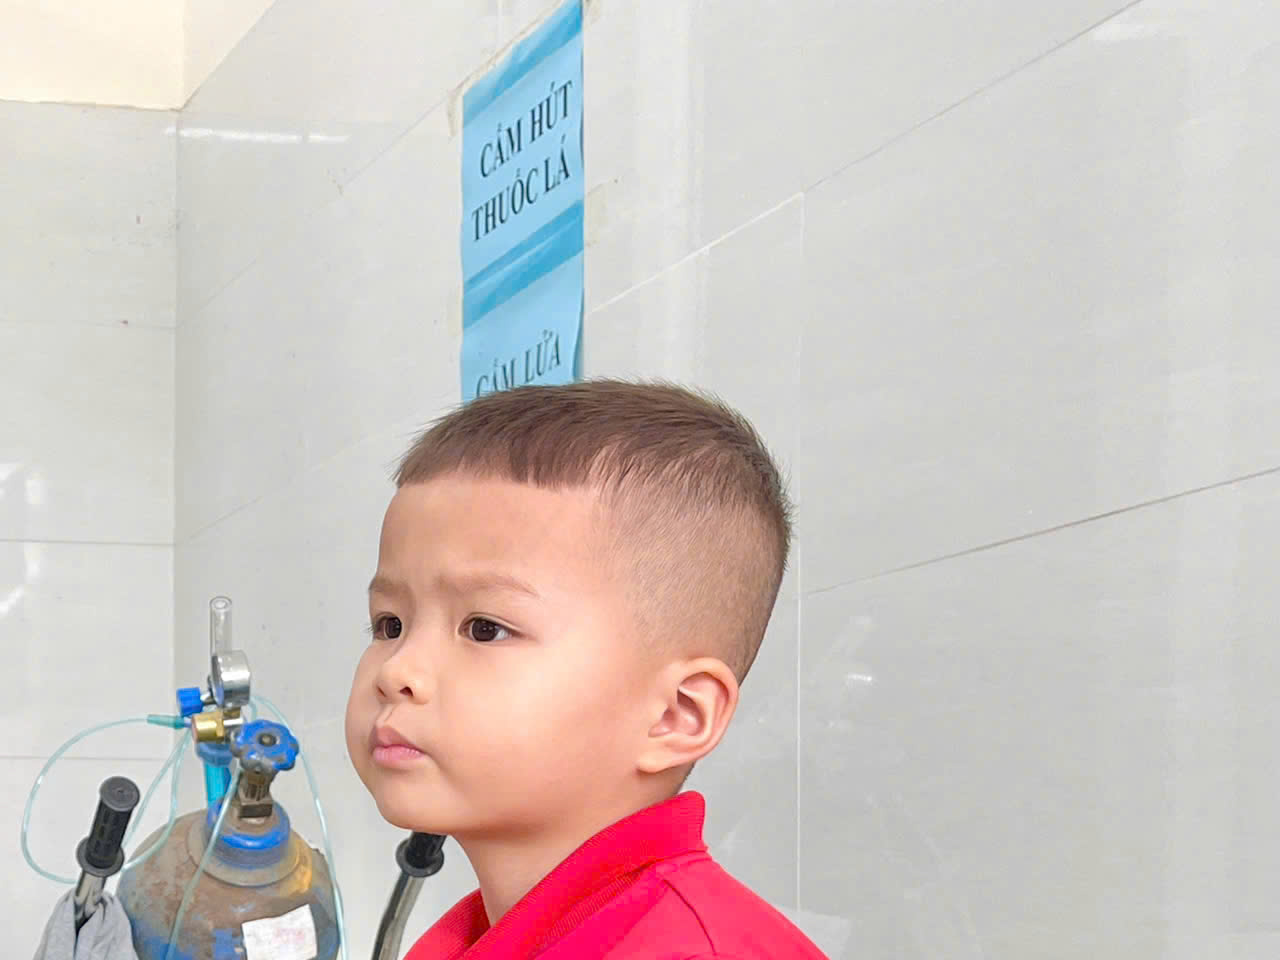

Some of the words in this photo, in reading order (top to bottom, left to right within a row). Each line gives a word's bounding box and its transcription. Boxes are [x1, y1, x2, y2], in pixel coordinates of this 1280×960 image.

[530, 80, 572, 144] HÚT
[472, 167, 538, 242] THUỐC
[544, 133, 570, 193] LÁ
[525, 329, 561, 384] LỬA
